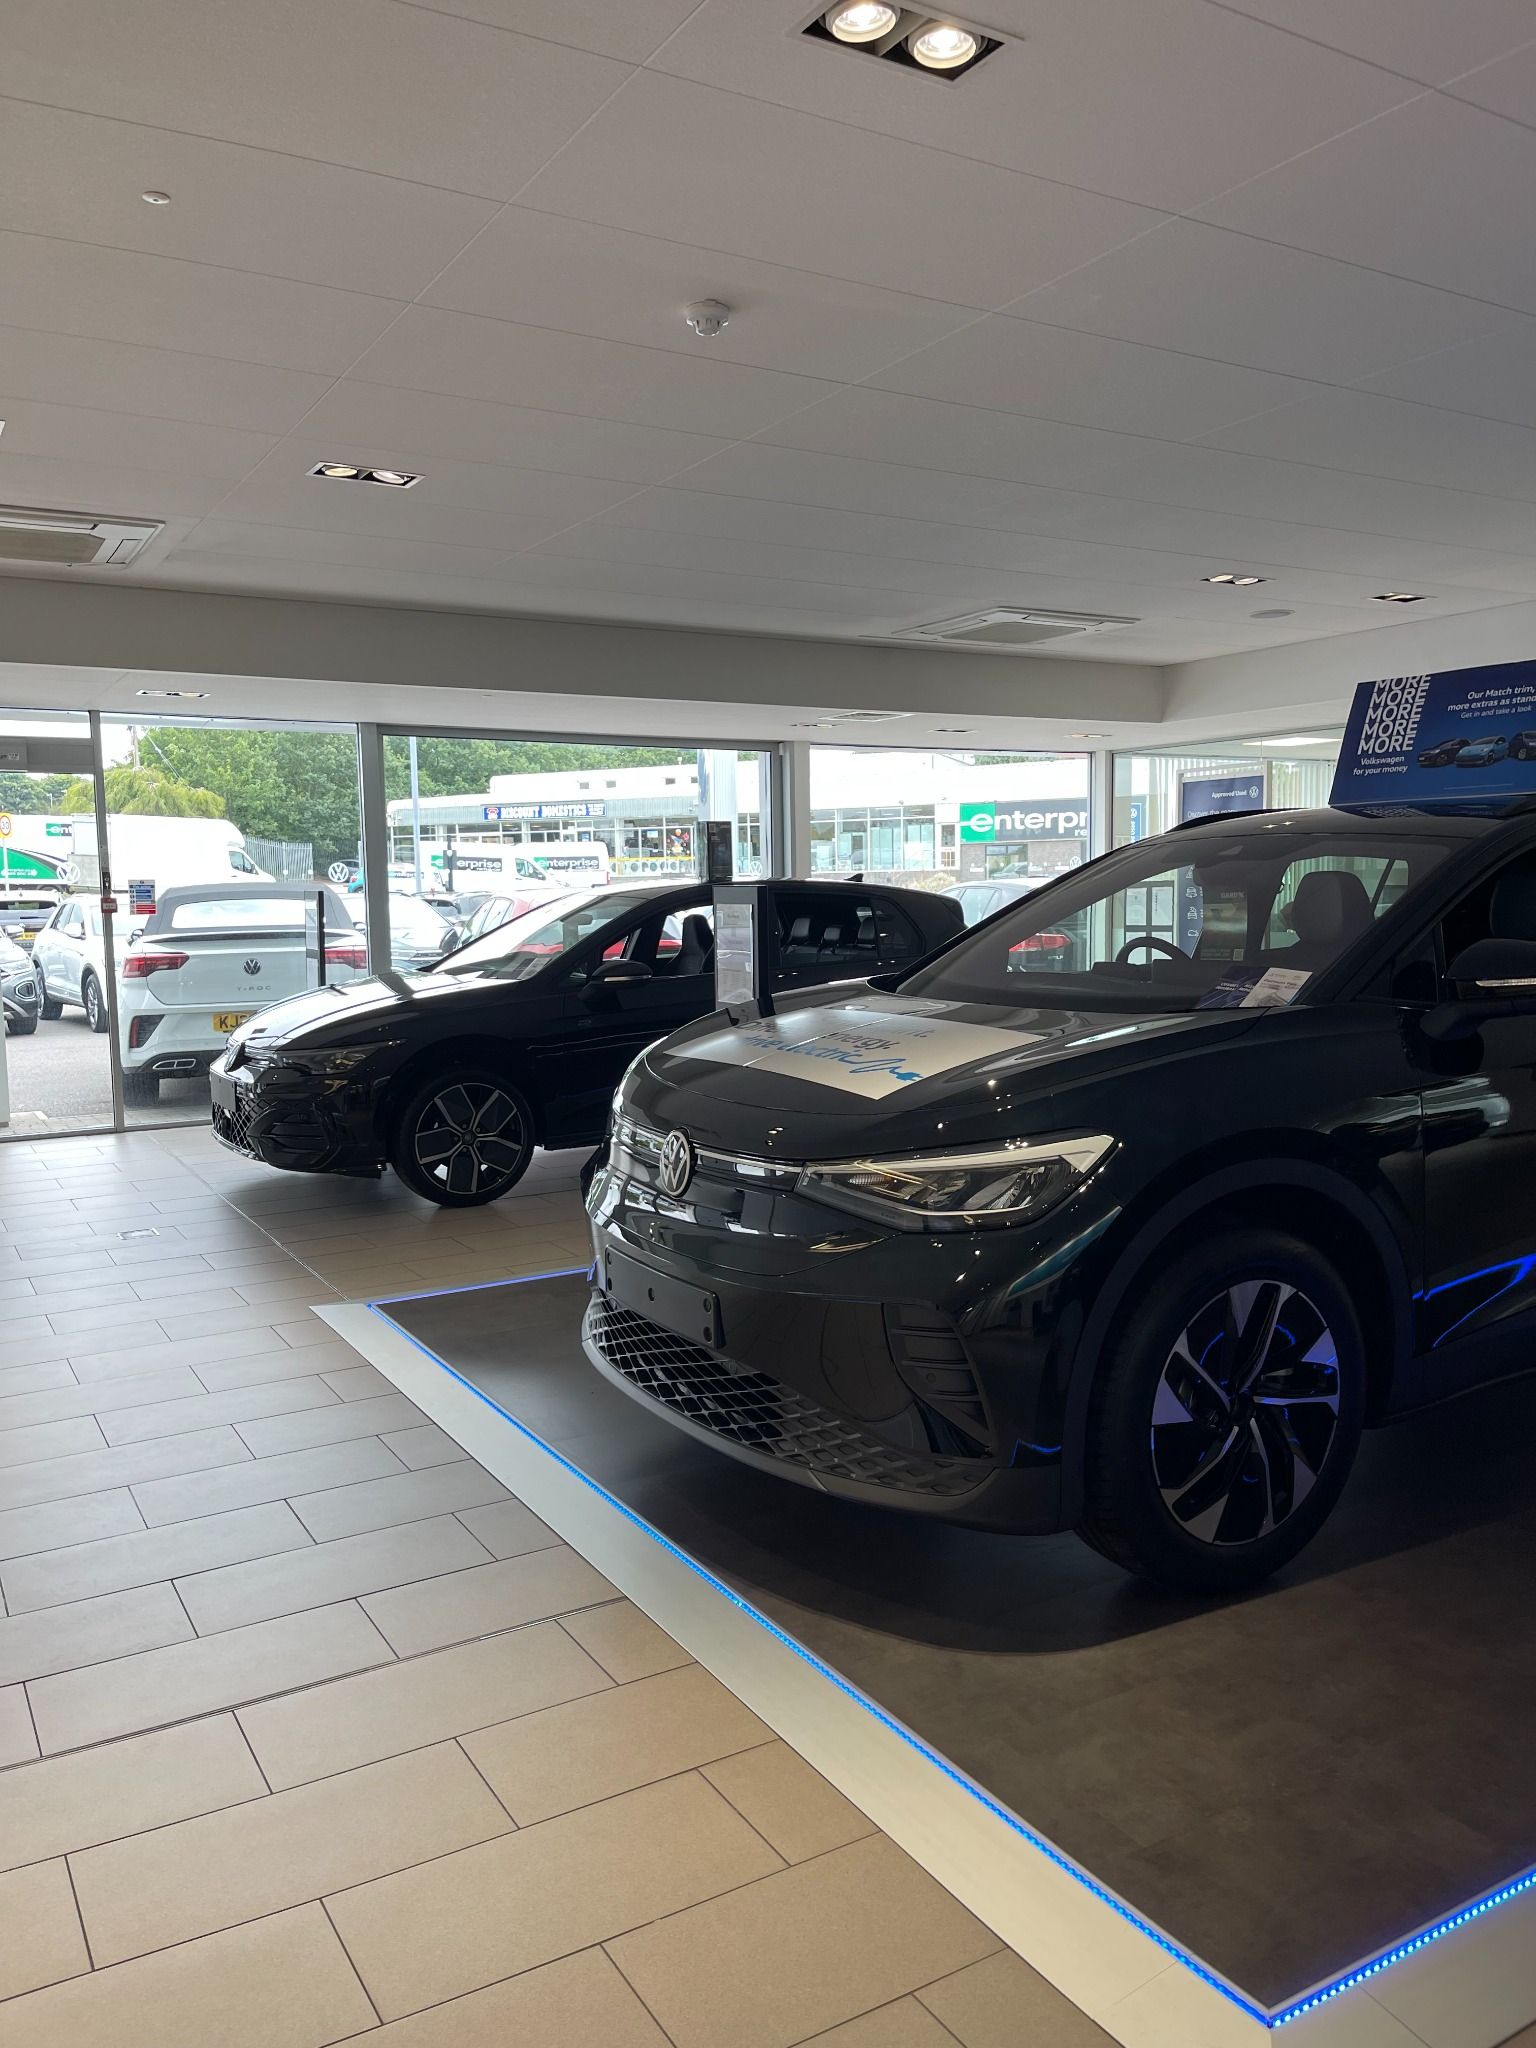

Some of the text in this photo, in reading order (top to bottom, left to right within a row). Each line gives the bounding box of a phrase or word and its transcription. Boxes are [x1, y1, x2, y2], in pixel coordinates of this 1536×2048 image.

[1374, 675, 1431, 693] MORE
[1370, 686, 1428, 708] MORE
[1467, 685, 1536, 700] Our Match trim,
[1365, 701, 1424, 723] MORE
[1447, 703, 1470, 712] more
[1471, 699, 1498, 709] extras
[1499, 698, 1510, 706] as
[1460, 711, 1472, 719] Get
[1481, 708, 1495, 717] and
[1495, 707, 1510, 715] take
[1516, 704, 1532, 713] look
[1361, 717, 1420, 739] MORE
[1357, 734, 1415, 755] MORE
[1361, 756, 1405, 766] Volkswagen
[1353, 765, 1408, 777] for your money
[1211, 790, 1235, 799] Approved
[541, 804, 587, 817] DOMESTICS
